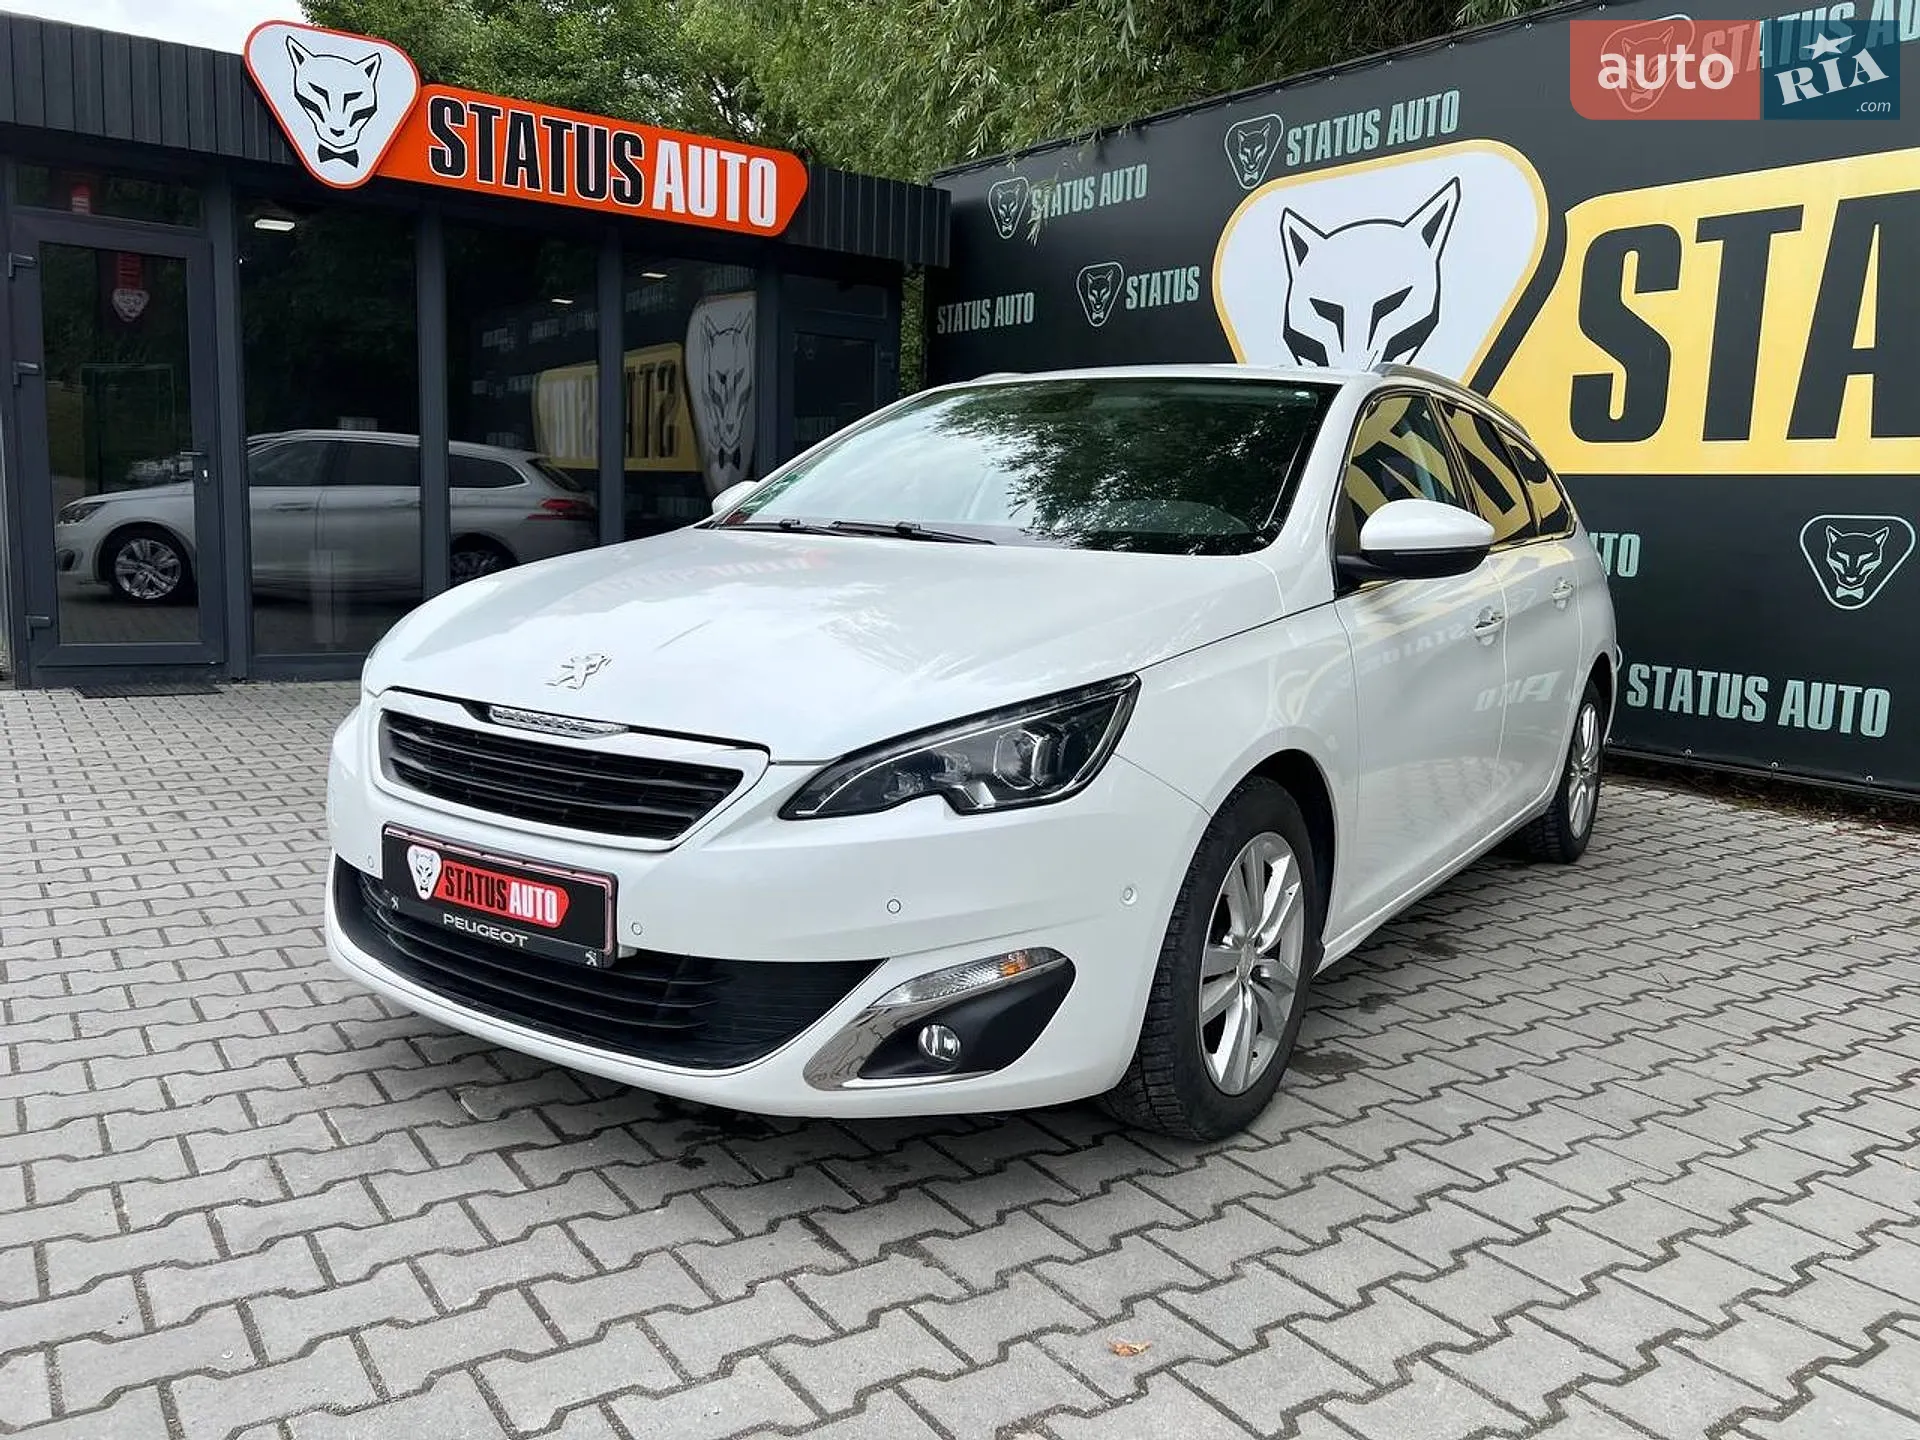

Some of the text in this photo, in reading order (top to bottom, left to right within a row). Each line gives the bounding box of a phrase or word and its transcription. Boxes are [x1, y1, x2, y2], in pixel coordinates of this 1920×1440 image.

[1286, 90, 1460, 166] STATUS AUTO
[427, 95, 777, 228] STATUS AUTO
[1031, 163, 1148, 220] STATUS AUTO
[937, 292, 1035, 334] STATUS AUTO
[1126, 266, 1200, 310] STATUS
[1570, 189, 1920, 443] STA
[1627, 663, 1891, 739] STATUS AUTO
[444, 866, 558, 923] STATUS AUTO
[443, 913, 528, 948] PEUGEOT
